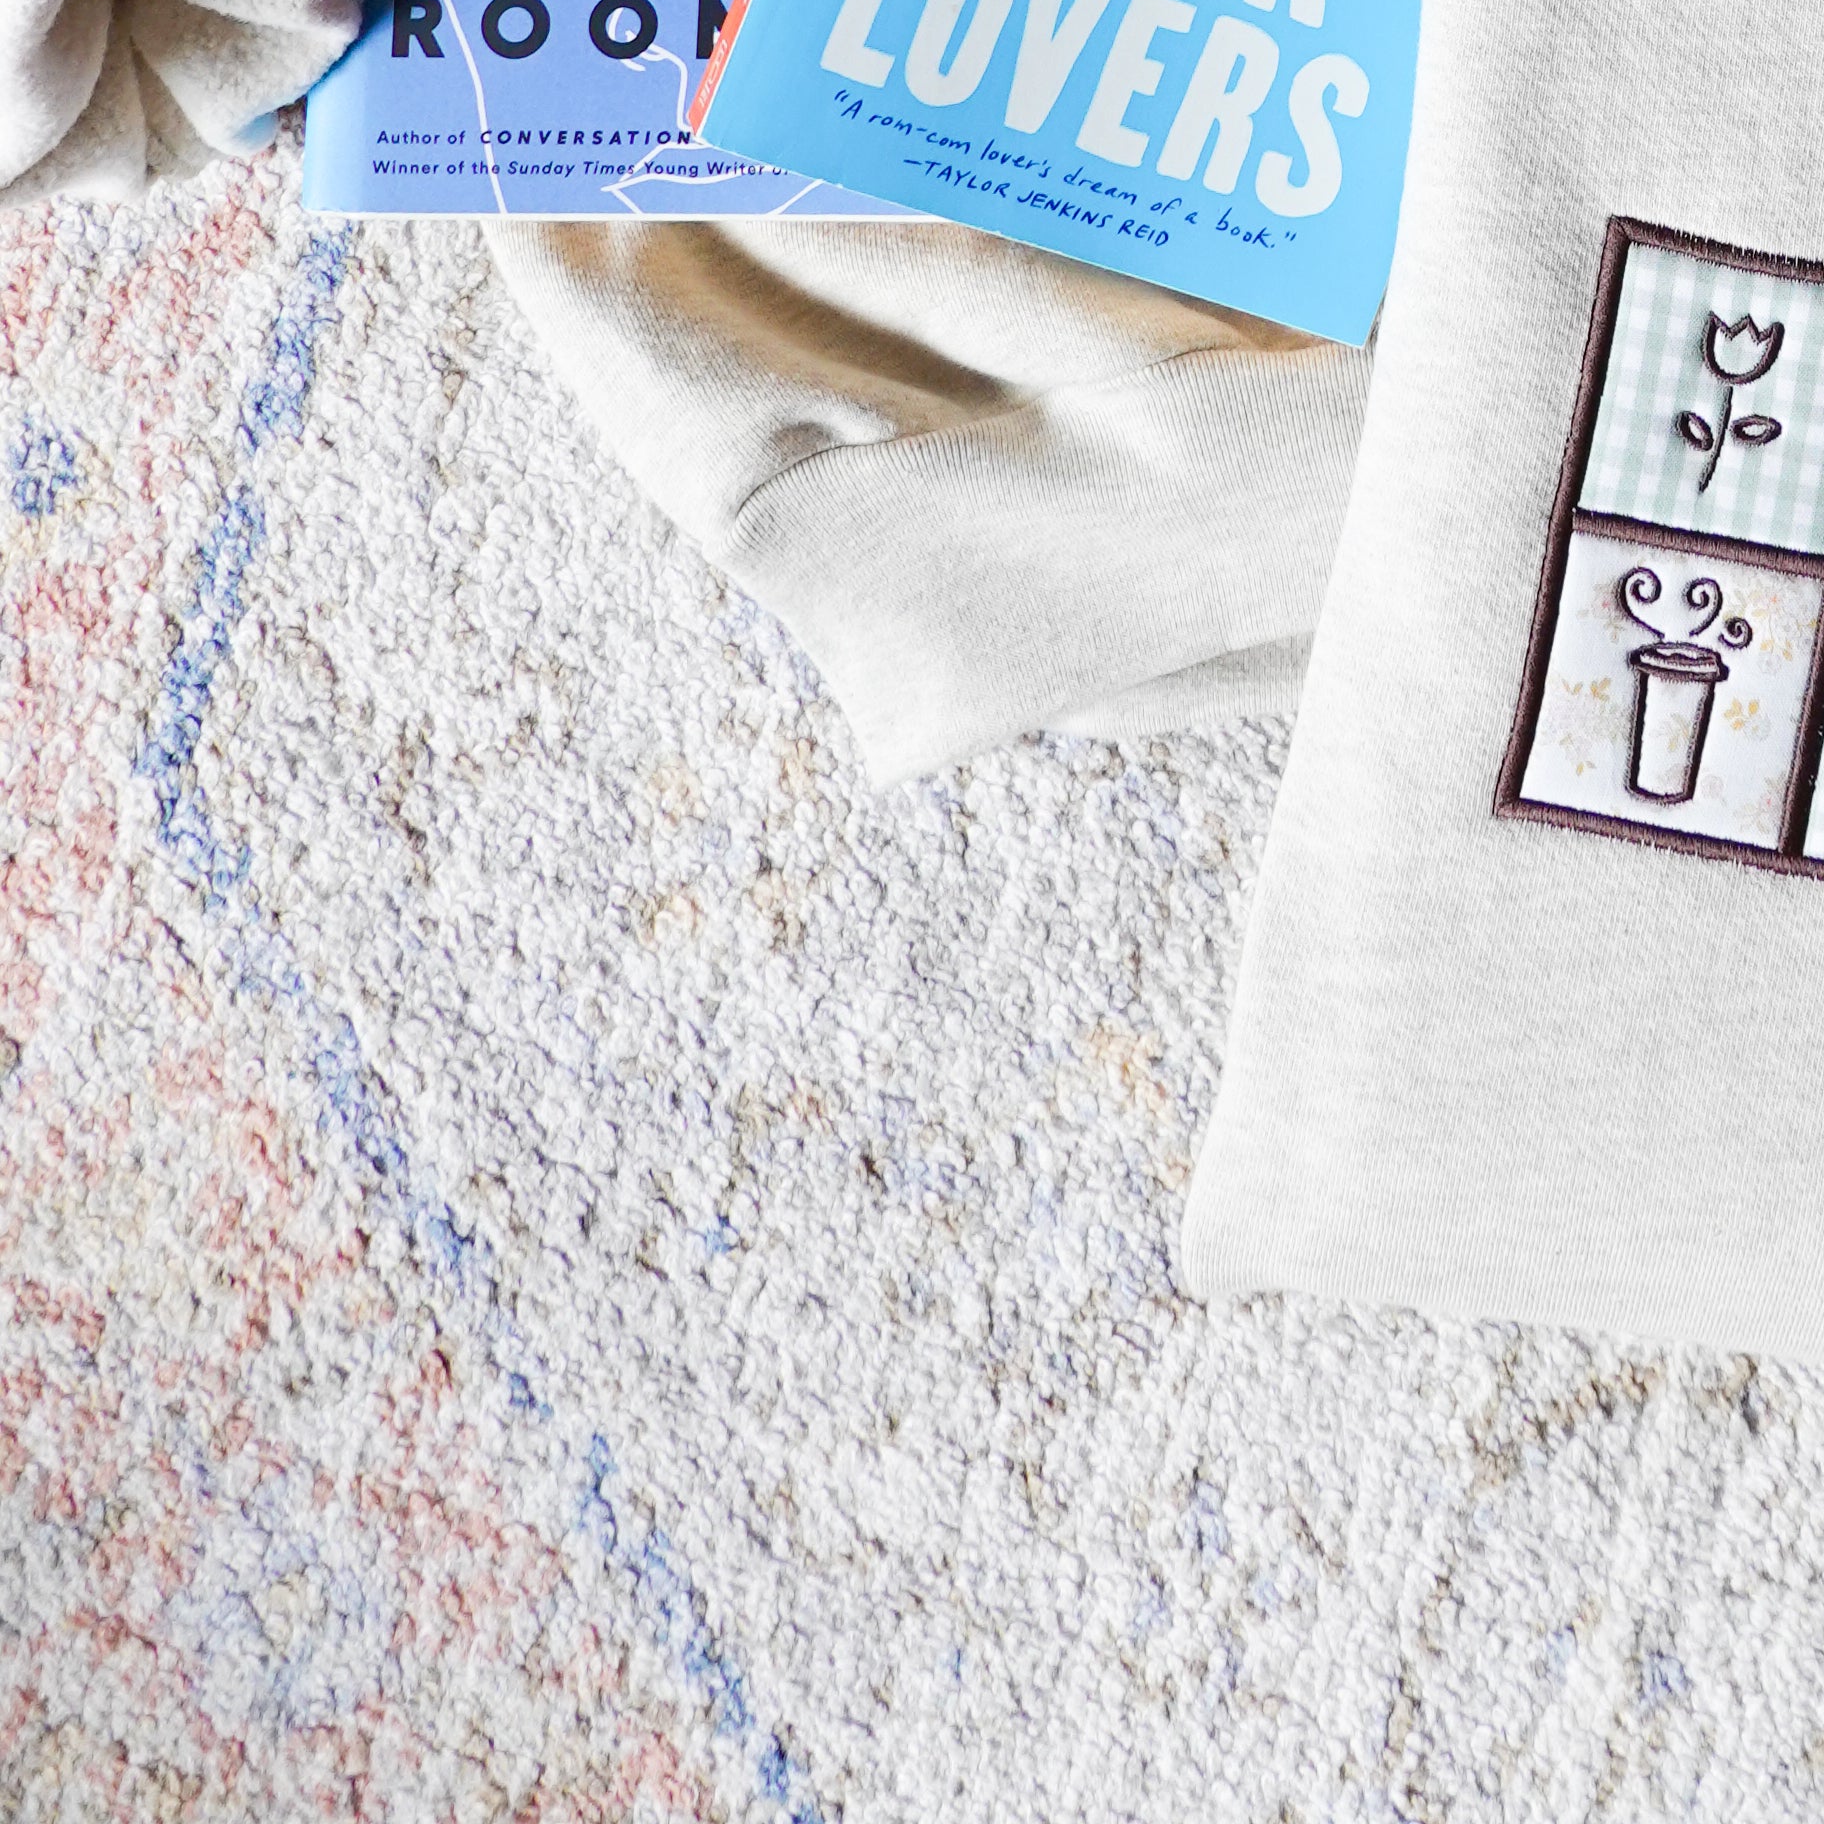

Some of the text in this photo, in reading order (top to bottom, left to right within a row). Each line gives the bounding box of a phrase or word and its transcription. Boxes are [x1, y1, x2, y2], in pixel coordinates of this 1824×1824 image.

[377, 127, 692, 148] Author of CONVERSATION
[373, 160, 439, 174] Winner
[447, 161, 464, 174] of
[470, 159, 500, 175] the
[508, 161, 575, 177] Sunday
[582, 158, 635, 176] Times
[643, 159, 698, 179] Young
[706, 160, 763, 176] Writer
[869, 115, 970, 154] rom-com
[980, 139, 1051, 178] lover's
[1064, 167, 1137, 205] dream
[1150, 198, 1182, 215] of
[1185, 212, 1198, 224] a
[1017, 191, 1113, 227] JENKINS
[1118, 220, 1168, 246] REID
